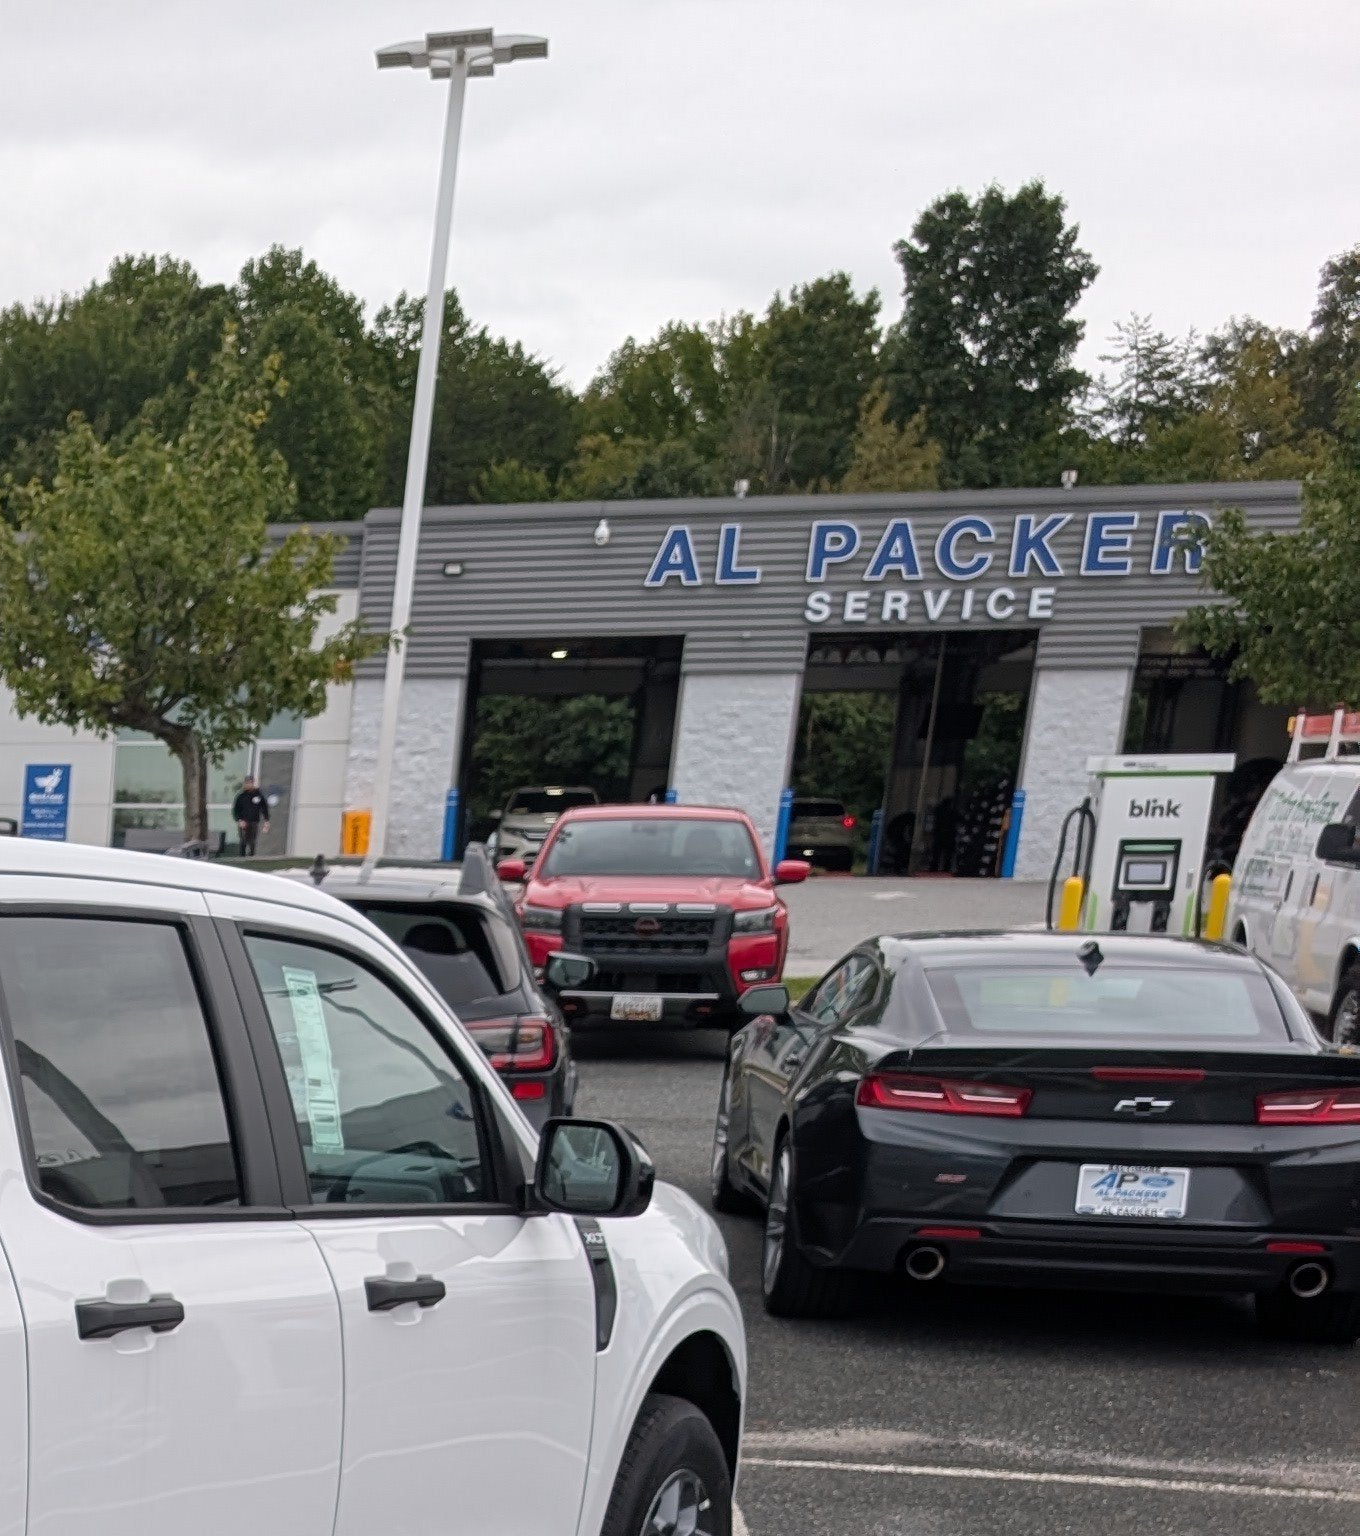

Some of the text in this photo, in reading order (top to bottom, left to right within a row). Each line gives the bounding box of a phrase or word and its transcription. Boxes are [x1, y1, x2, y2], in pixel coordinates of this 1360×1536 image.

[643, 510, 1213, 587] AL PACKER
[804, 586, 1056, 623] SERVICE
[1128, 798, 1182, 818] blink
[1091, 1171, 1139, 1189] AP
